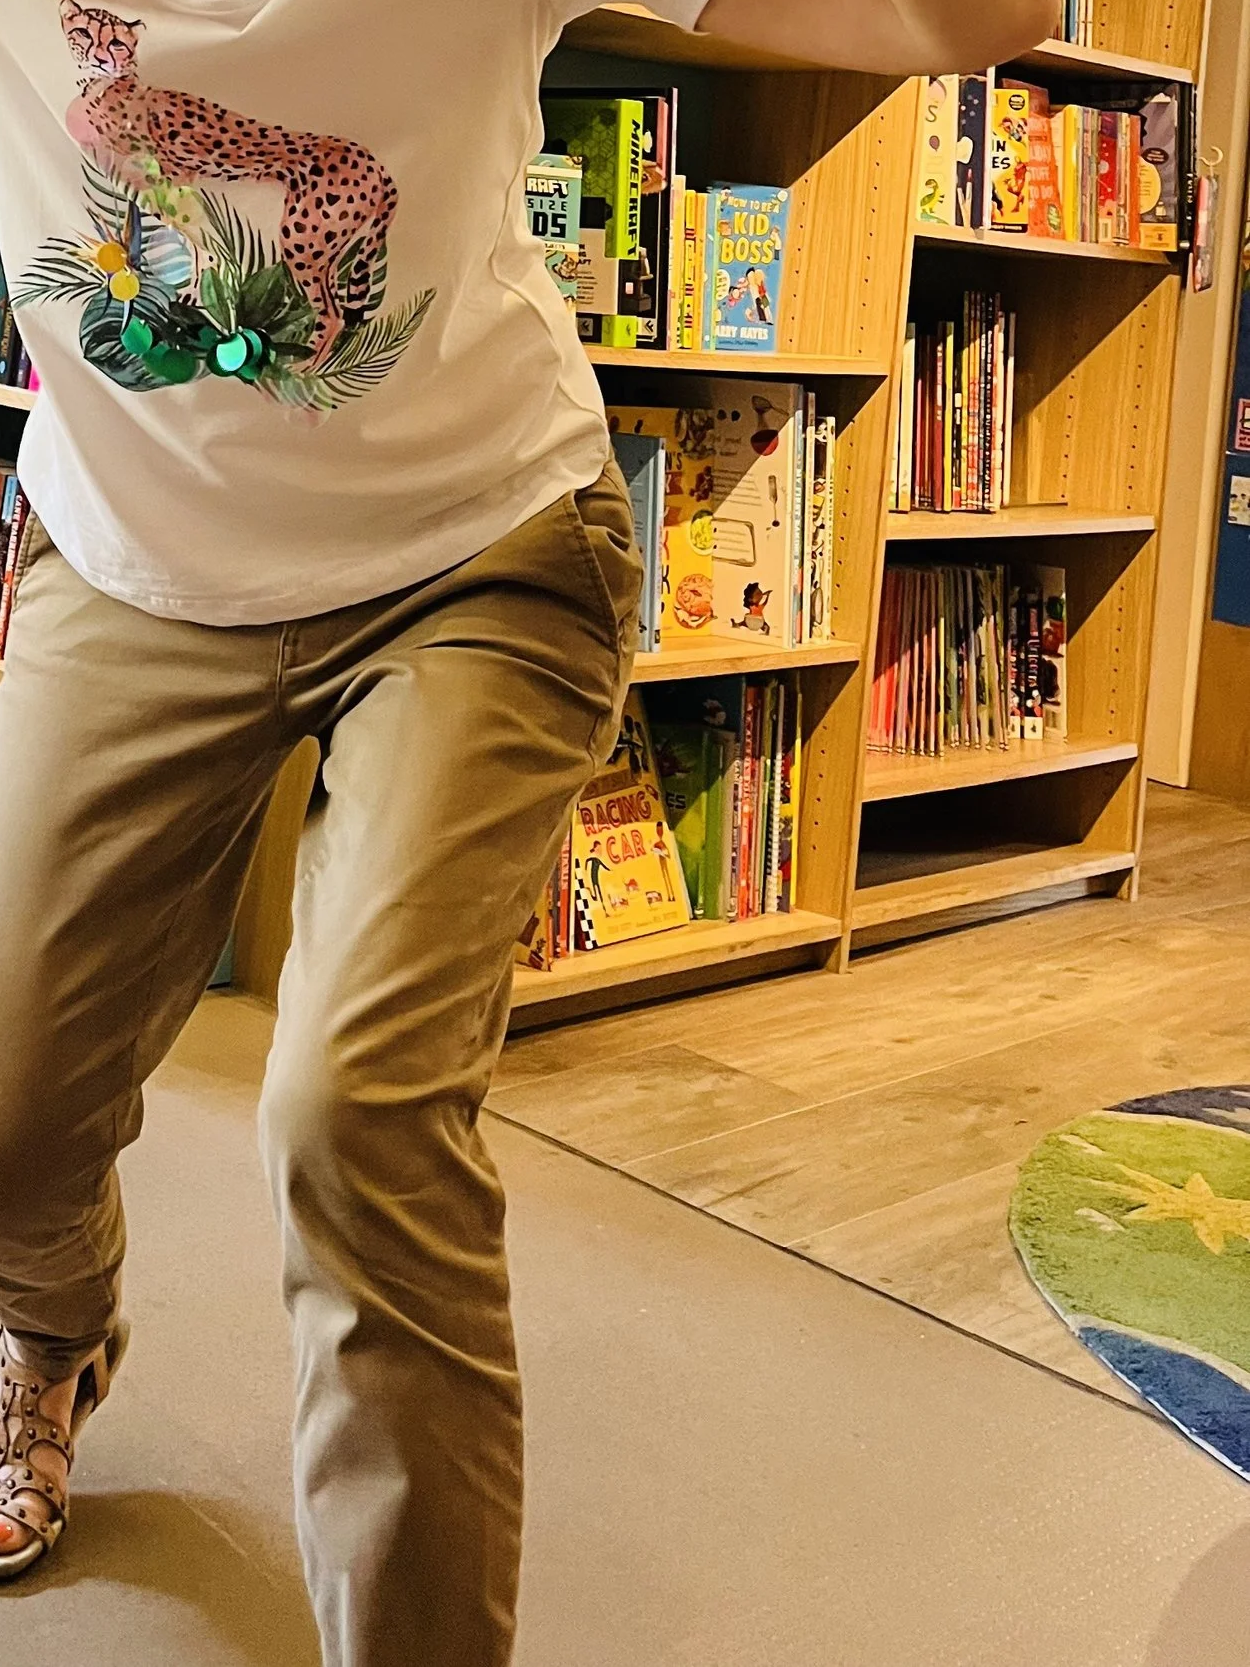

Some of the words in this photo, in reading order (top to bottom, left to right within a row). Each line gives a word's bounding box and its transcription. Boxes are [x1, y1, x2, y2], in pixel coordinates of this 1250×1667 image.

[527, 177, 568, 196] RAFT
[626, 118, 641, 256] MINECRAFT
[531, 213, 567, 240] DS
[733, 212, 770, 236] KID
[721, 237, 775, 264] BOSS
[579, 790, 653, 837] RACING
[605, 829, 647, 864] CAR
